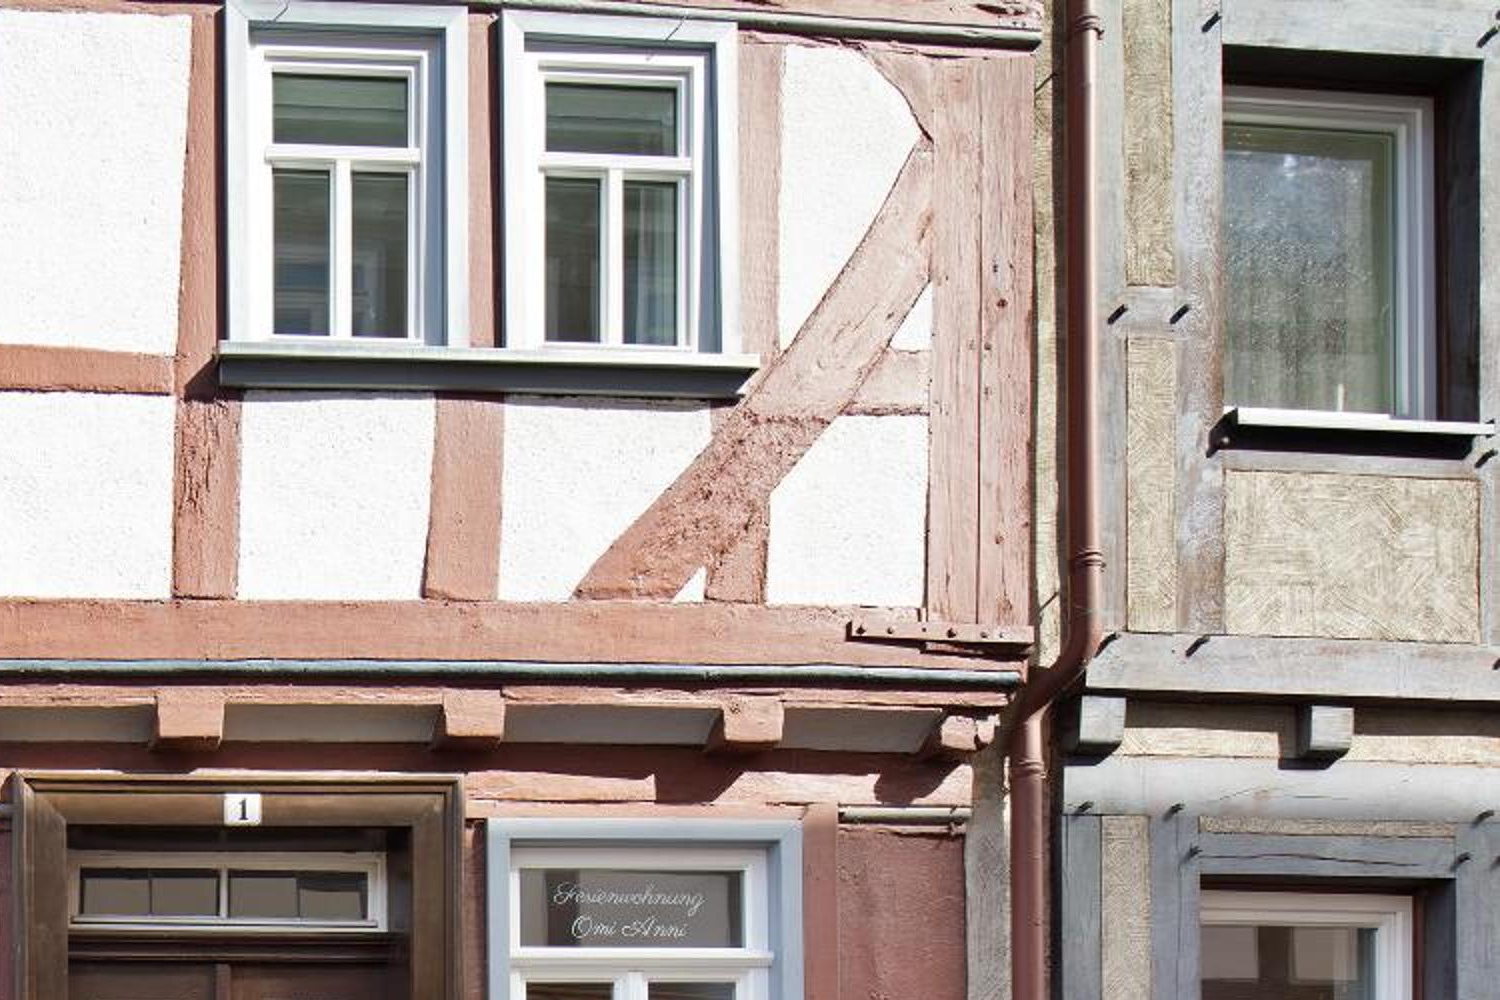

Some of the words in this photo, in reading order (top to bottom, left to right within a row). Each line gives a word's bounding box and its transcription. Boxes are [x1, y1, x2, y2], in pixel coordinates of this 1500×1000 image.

[238, 797, 249, 821] 1
[553, 881, 706, 917] Ferienwohnung
[571, 915, 617, 939] Omi
[621, 915, 689, 938] Anni
